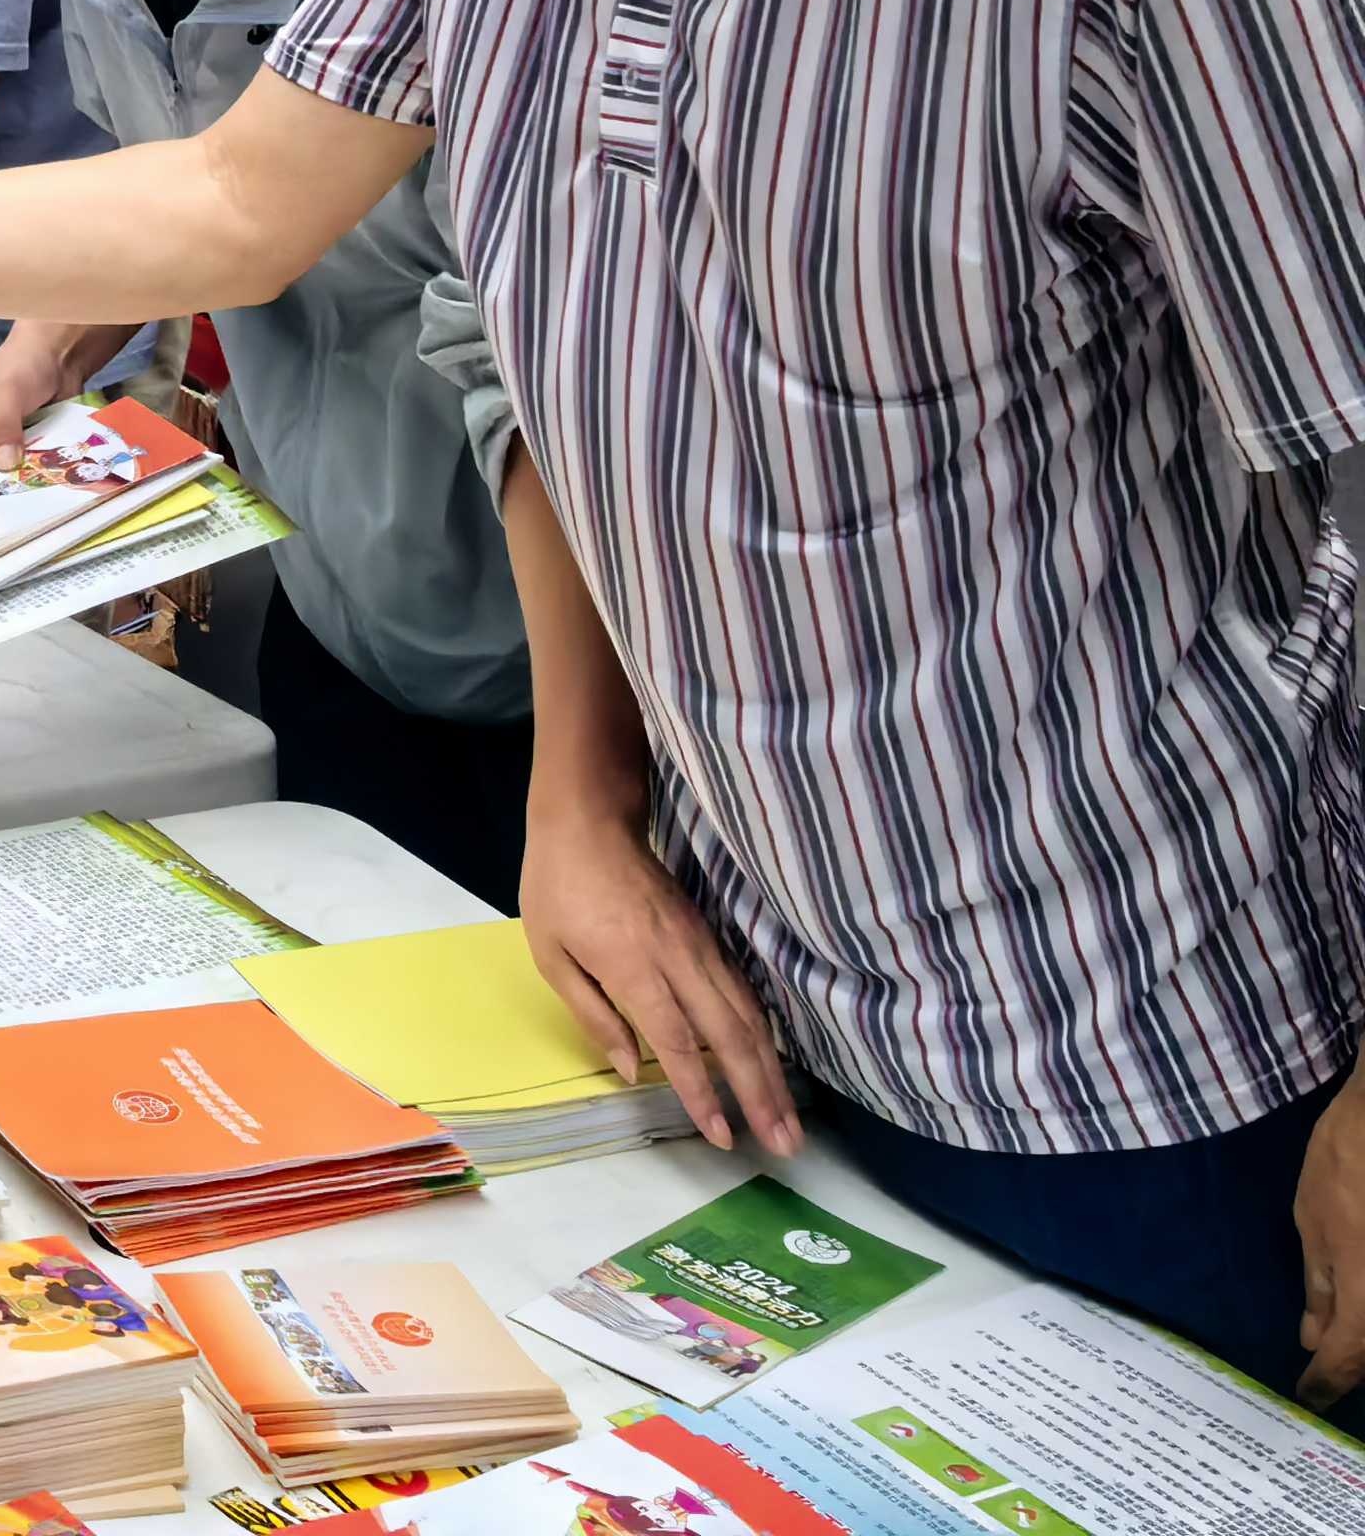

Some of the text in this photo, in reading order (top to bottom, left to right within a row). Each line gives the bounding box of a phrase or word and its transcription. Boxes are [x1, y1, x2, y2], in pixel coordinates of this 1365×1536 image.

[653, 1243, 824, 1327] 激发消费活力
[721, 1260, 798, 1296] 2024
